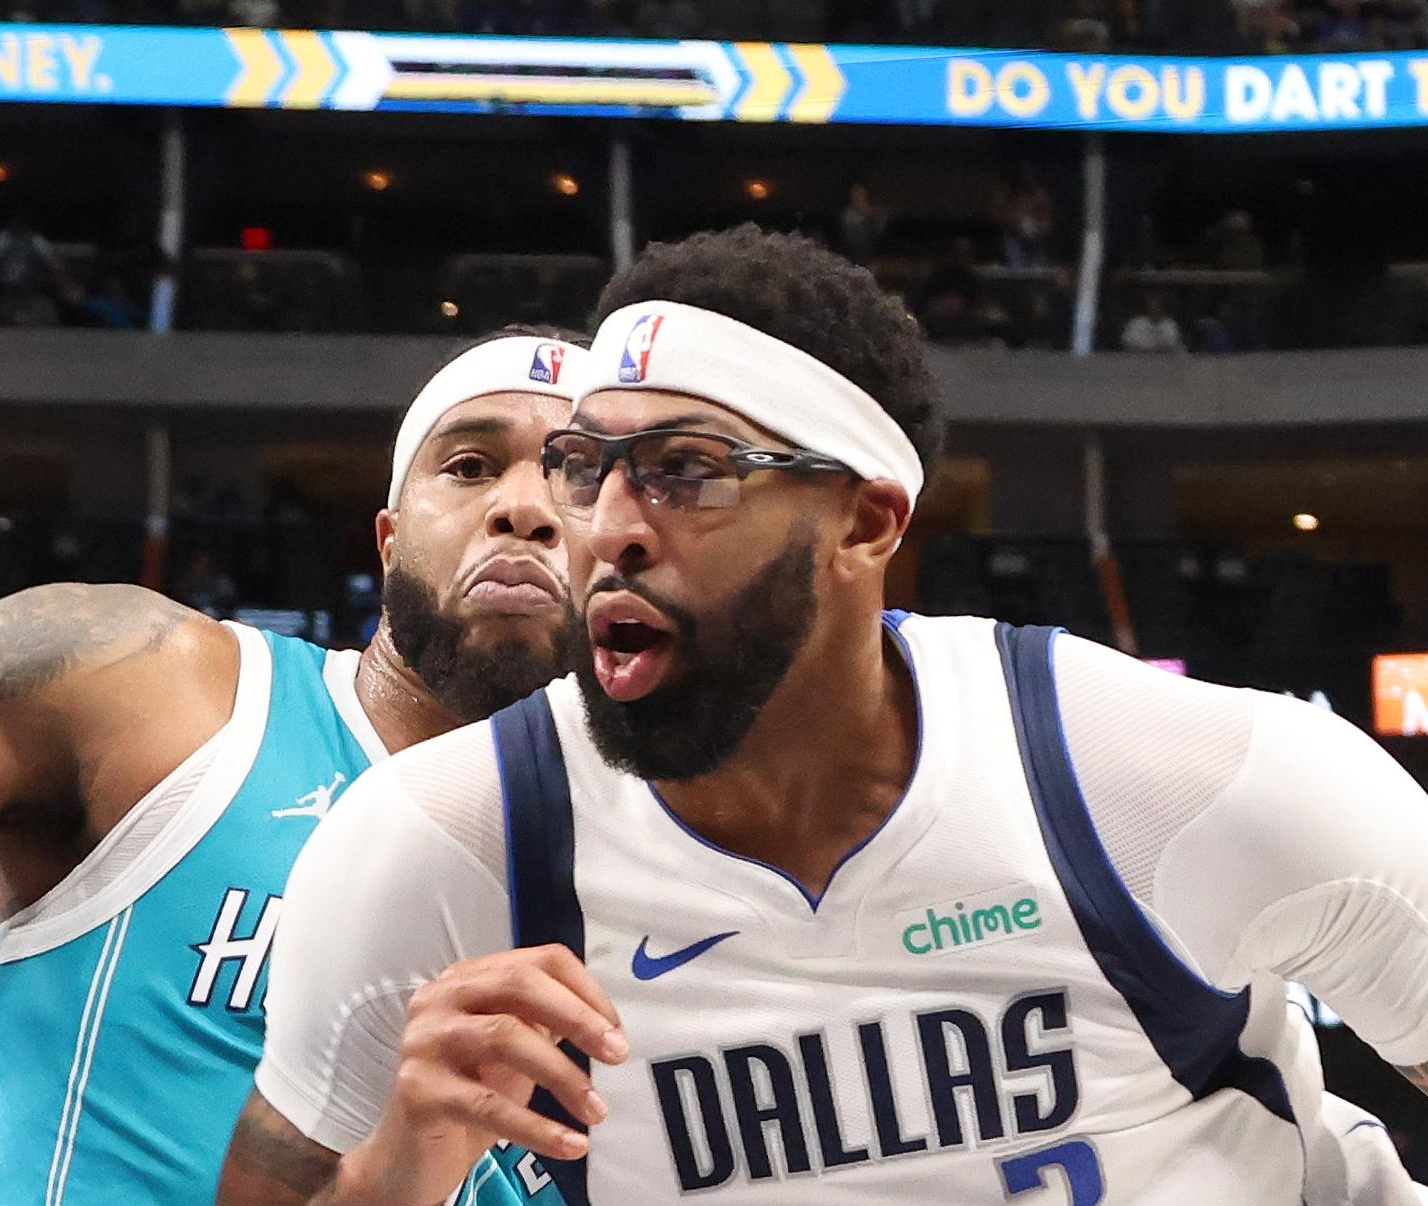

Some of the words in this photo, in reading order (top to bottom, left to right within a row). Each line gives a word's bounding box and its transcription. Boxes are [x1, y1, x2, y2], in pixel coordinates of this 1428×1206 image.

[946, 59, 1051, 118] DO
[1066, 62, 1203, 122] YOU
[1224, 60, 1394, 123] DART
[901, 895, 1044, 956] chime
[649, 984, 1080, 1197] DALLAS
